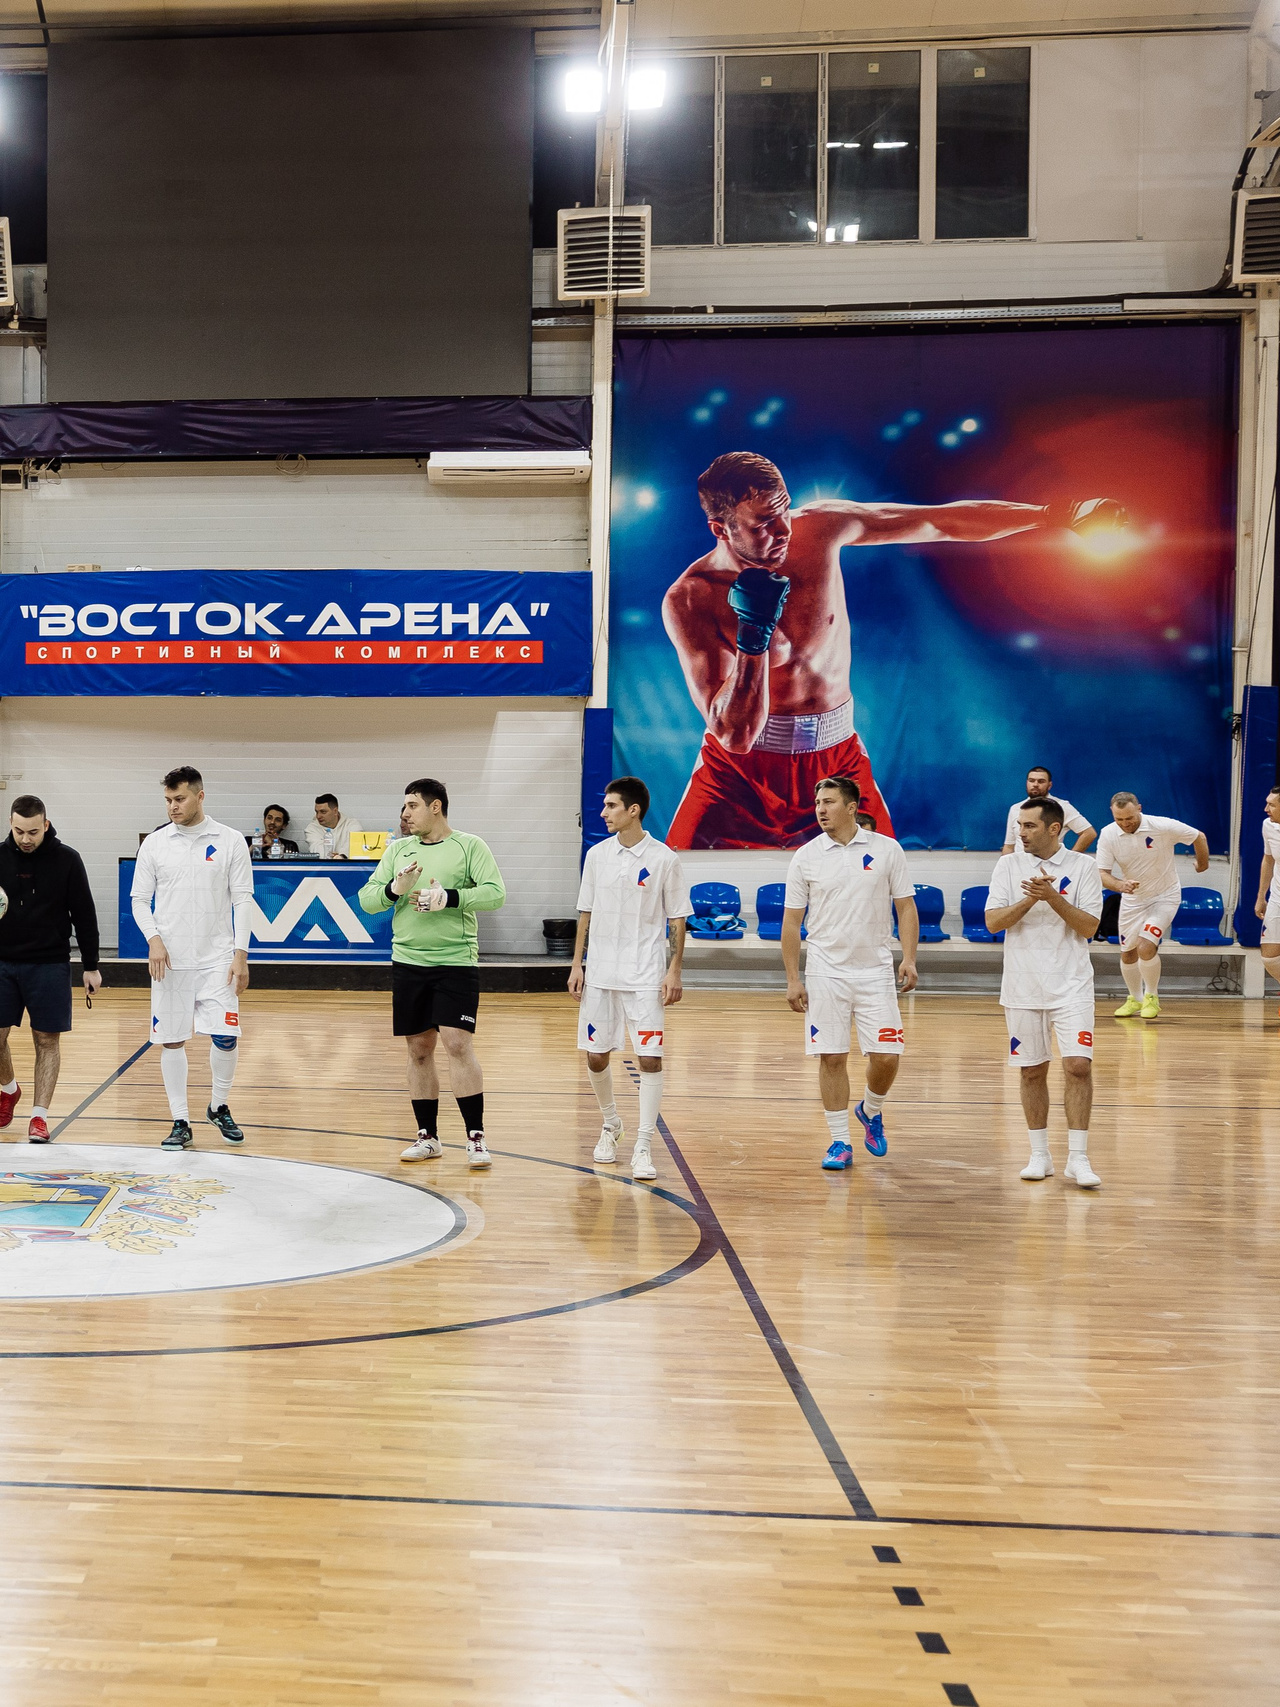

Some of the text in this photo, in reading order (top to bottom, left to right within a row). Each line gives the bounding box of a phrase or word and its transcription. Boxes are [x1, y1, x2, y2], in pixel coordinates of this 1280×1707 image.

[19, 602, 550, 637] "ВОСТОК-АРЕНА"
[37, 644, 531, 659] СПОРТИВНЫЙ КОМПЛЕКС
[1143, 923, 1163, 938] 10
[224, 1011, 239, 1027] 5
[637, 1030, 663, 1046] 77
[1077, 1030, 1093, 1048] 8
